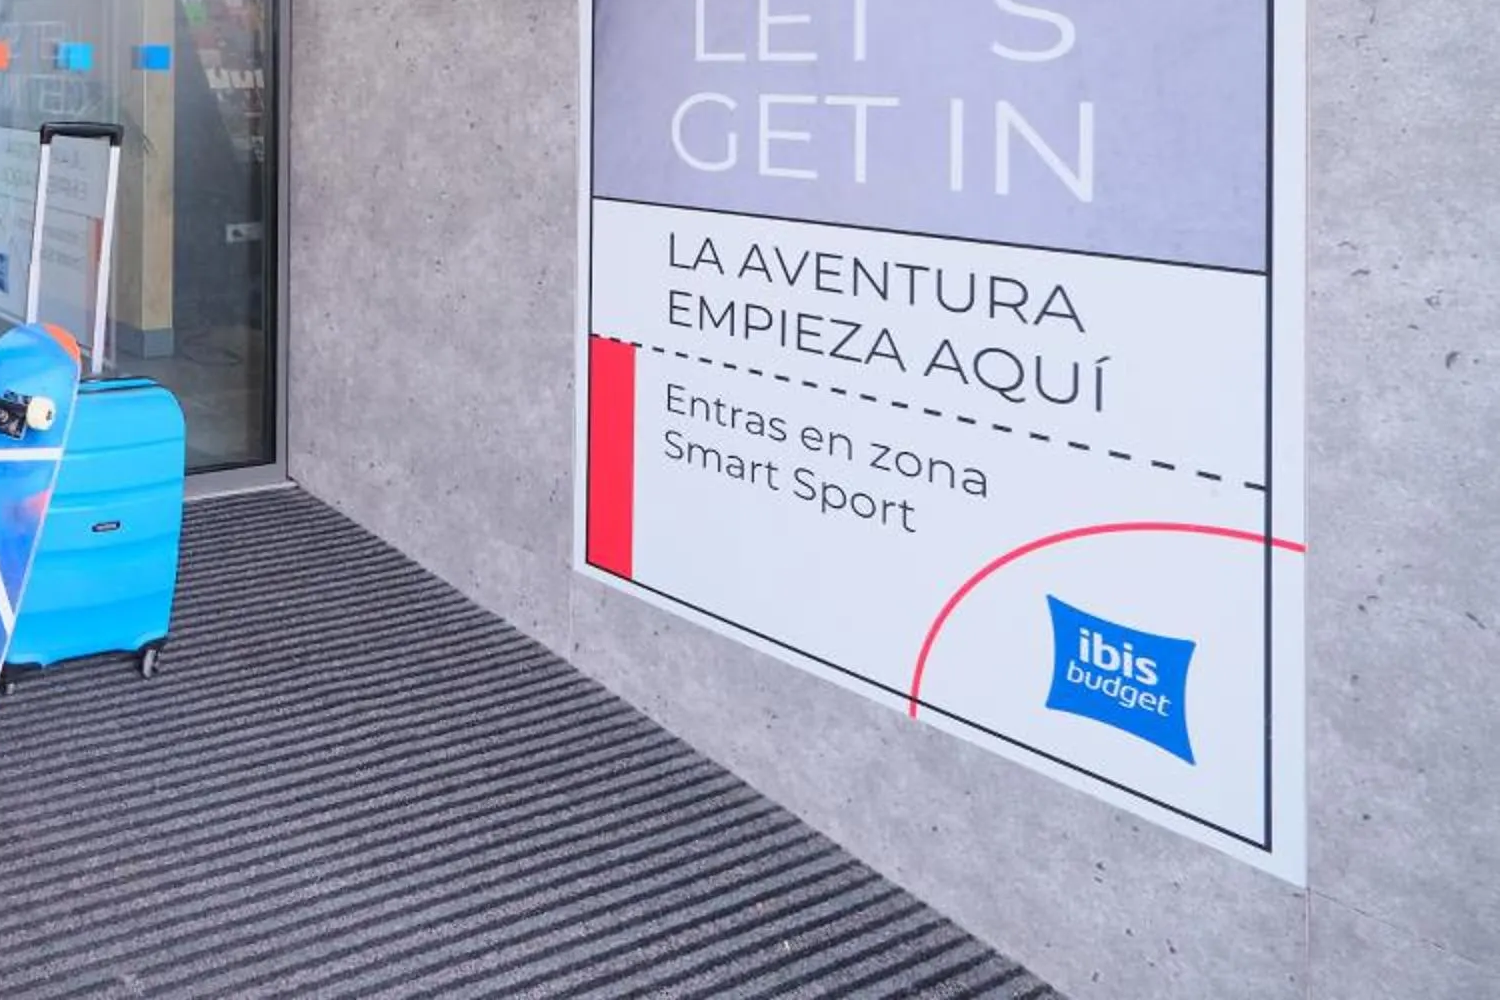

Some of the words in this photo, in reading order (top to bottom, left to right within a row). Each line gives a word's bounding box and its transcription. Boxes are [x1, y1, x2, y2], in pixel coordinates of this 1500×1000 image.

[671, 91, 900, 184] GET
[950, 97, 1093, 203] IN
[668, 231, 725, 275] LA
[738, 243, 1086, 333] AVENTURA
[668, 289, 907, 373] EMPIEZA
[922, 338, 1111, 413] AQUÍ
[664, 429, 781, 491] Smart
[792, 467, 917, 534] Sport
[665, 382, 789, 442] Entras
[800, 425, 854, 462] en
[869, 440, 989, 500] zona
[1066, 660, 1173, 717] budget
[1079, 627, 1159, 686] ibis
